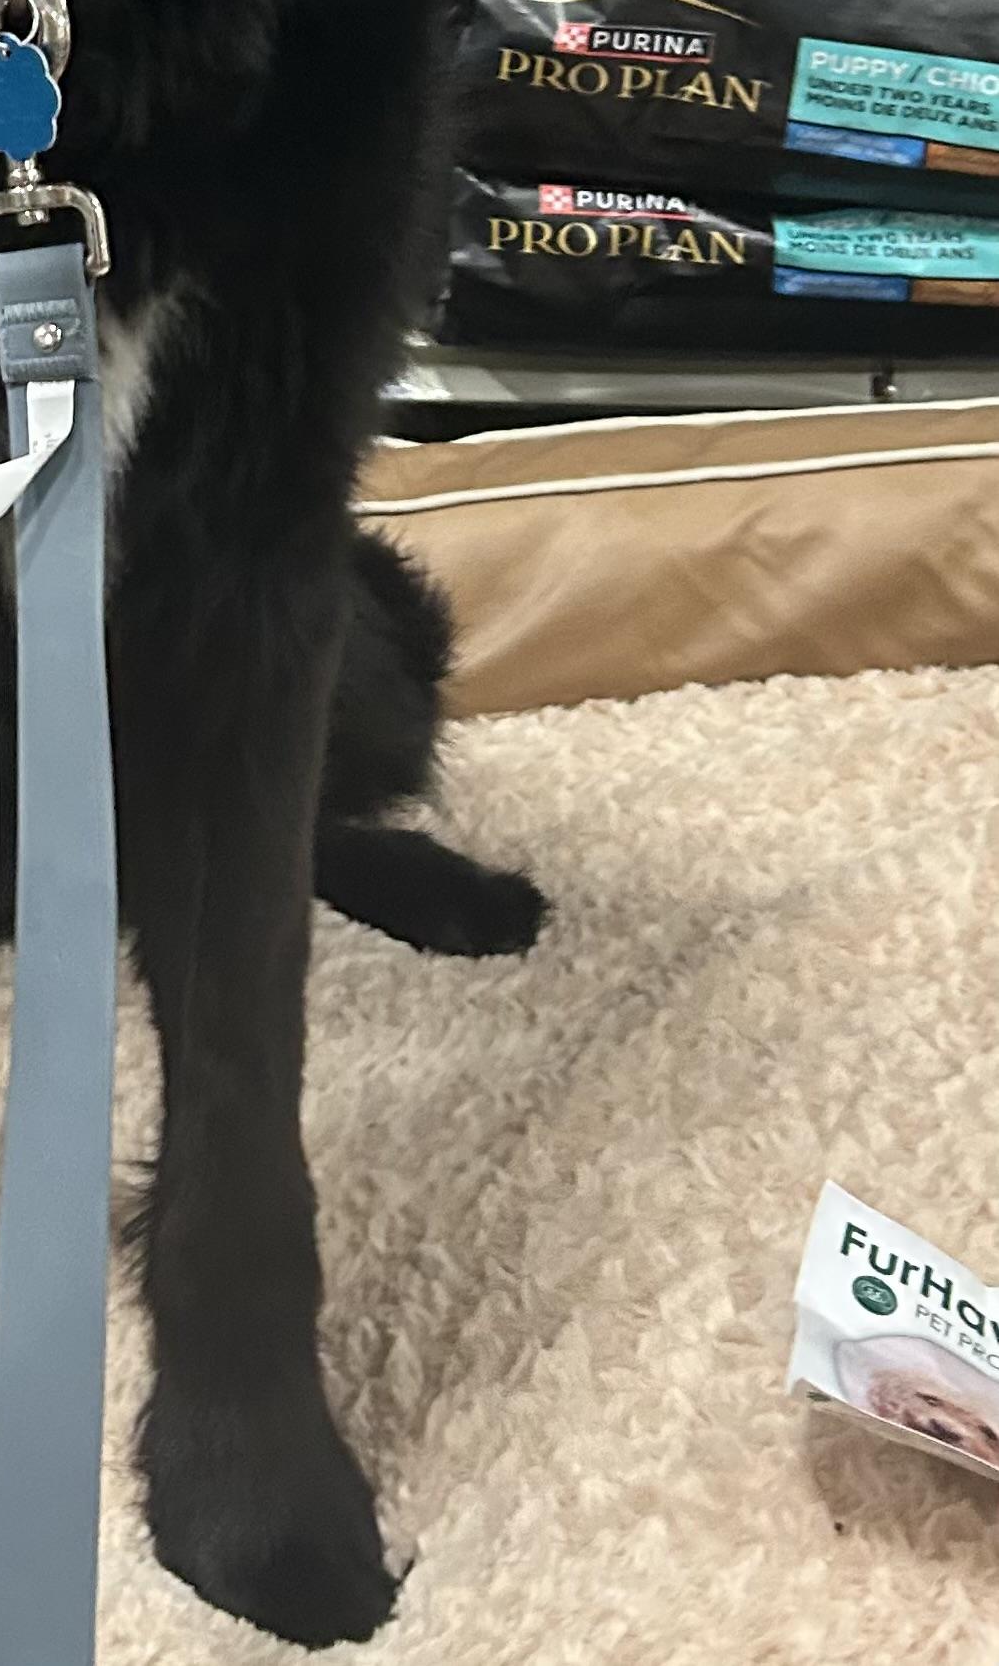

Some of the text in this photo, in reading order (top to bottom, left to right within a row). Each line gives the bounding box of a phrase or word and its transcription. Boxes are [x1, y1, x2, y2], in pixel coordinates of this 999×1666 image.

[592, 31, 706, 56] PURINA
[810, 51, 910, 81] PUPPY
[927, 66, 999, 95] CHIO
[806, 92, 998, 132] MOINS DE DEUX ANS
[808, 77, 991, 116] UNDER TWO YEARS
[576, 190, 687, 212] PURINA
[853, 243, 878, 256] DE
[882, 245, 932, 259] DEUX
[937, 246, 976, 260] ANS
[915, 1304, 953, 1337] PET
